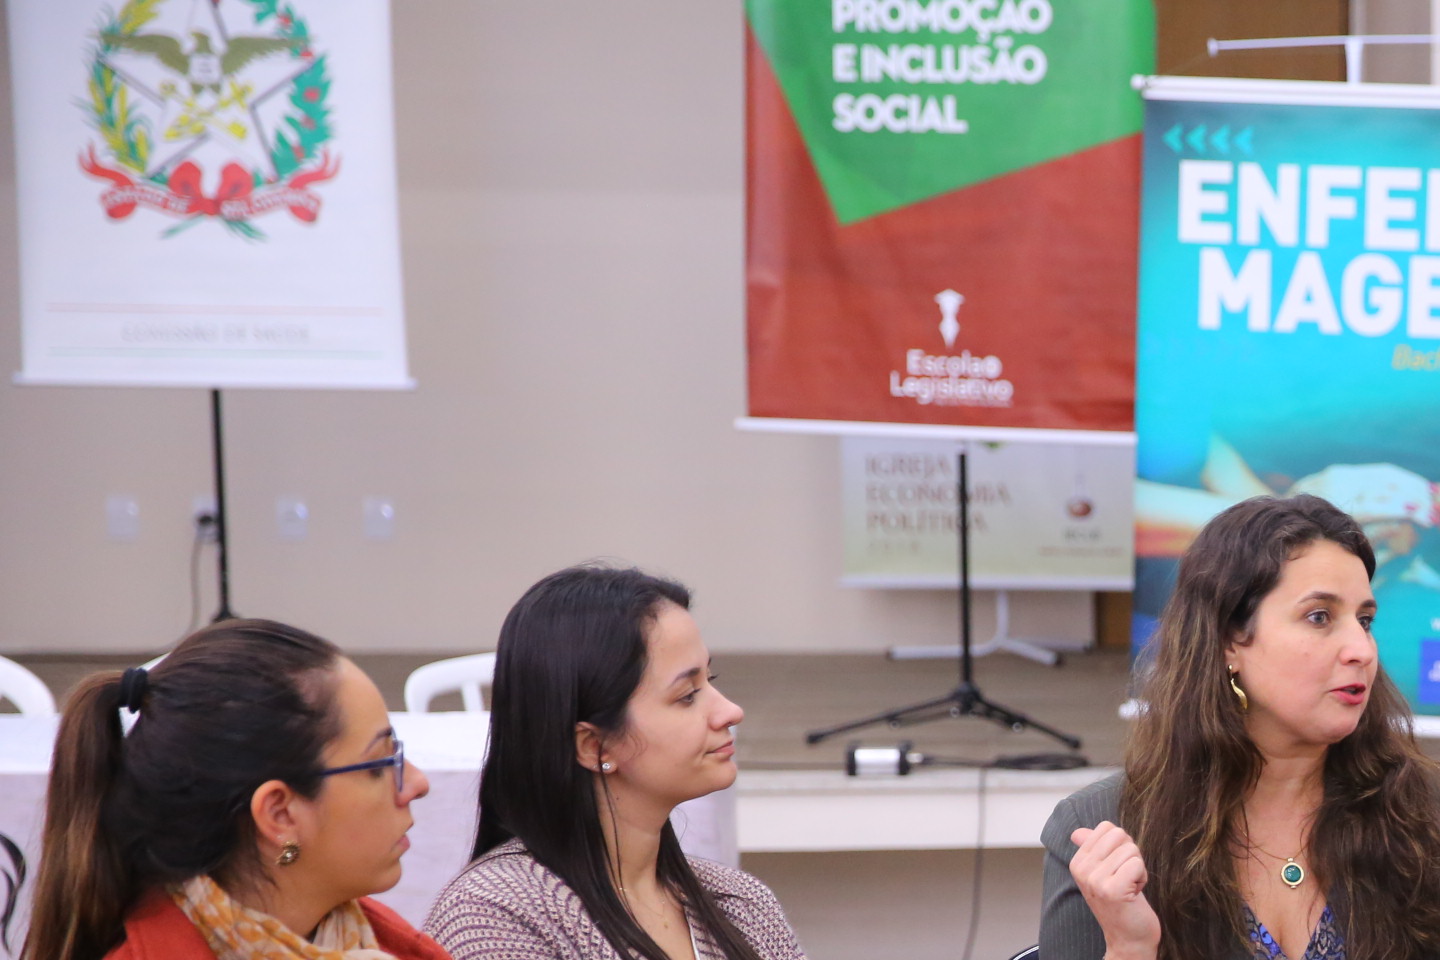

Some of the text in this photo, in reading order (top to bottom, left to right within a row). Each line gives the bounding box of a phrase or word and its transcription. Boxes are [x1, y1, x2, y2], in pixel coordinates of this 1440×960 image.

[832, 35, 1048, 84] E INCLUSÃO
[832, 92, 969, 134] SOCIAL
